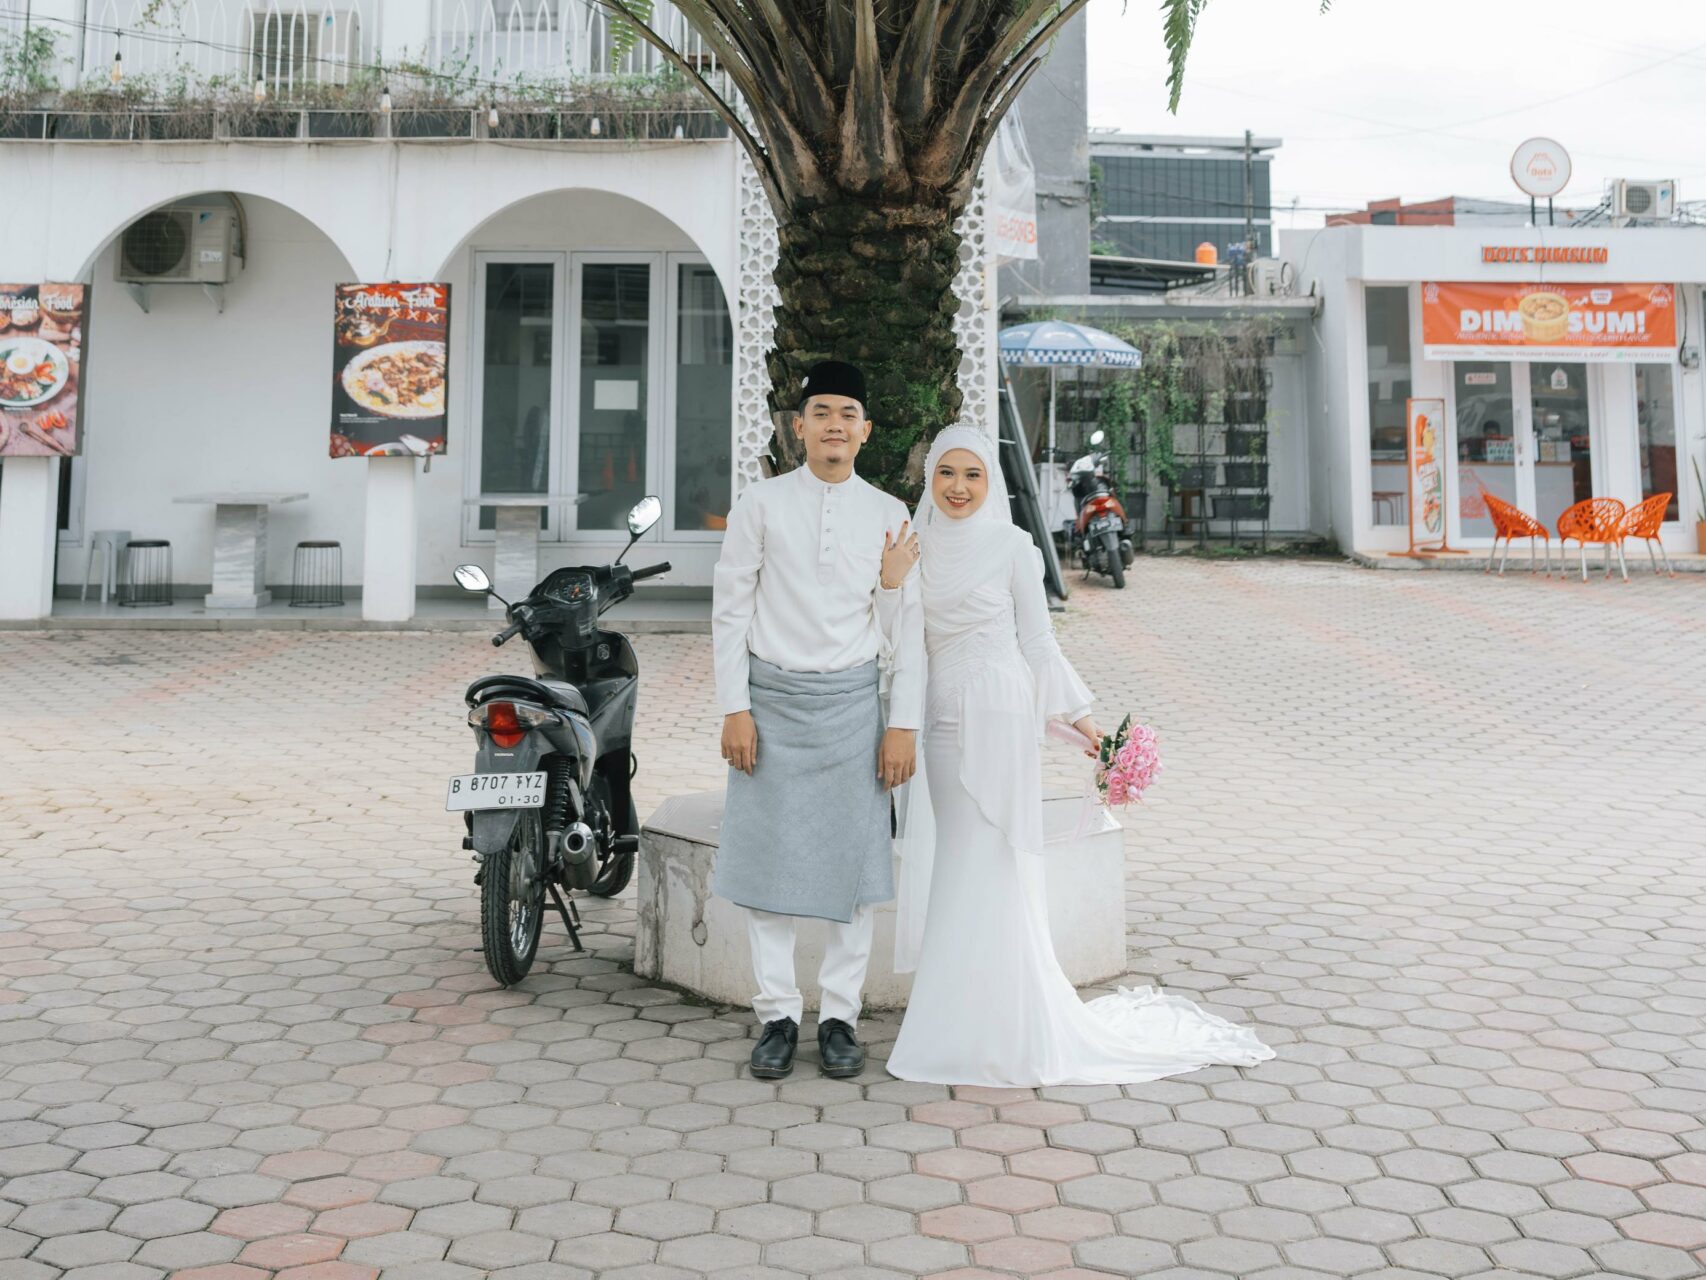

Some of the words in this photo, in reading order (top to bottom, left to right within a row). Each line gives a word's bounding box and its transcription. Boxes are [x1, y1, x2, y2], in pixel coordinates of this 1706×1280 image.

[1482, 246, 1529, 263] DOTS
[1534, 246, 1608, 264] DIMSUM
[45, 292, 74, 311] Food
[345, 291, 400, 309] Arabian
[404, 288, 436, 308] Food
[1460, 309, 1522, 332] DIM
[1568, 310, 1646, 334] SUM!
[452, 779, 461, 794] B
[471, 776, 508, 791] 8707
[516, 774, 543, 789] TYZ
